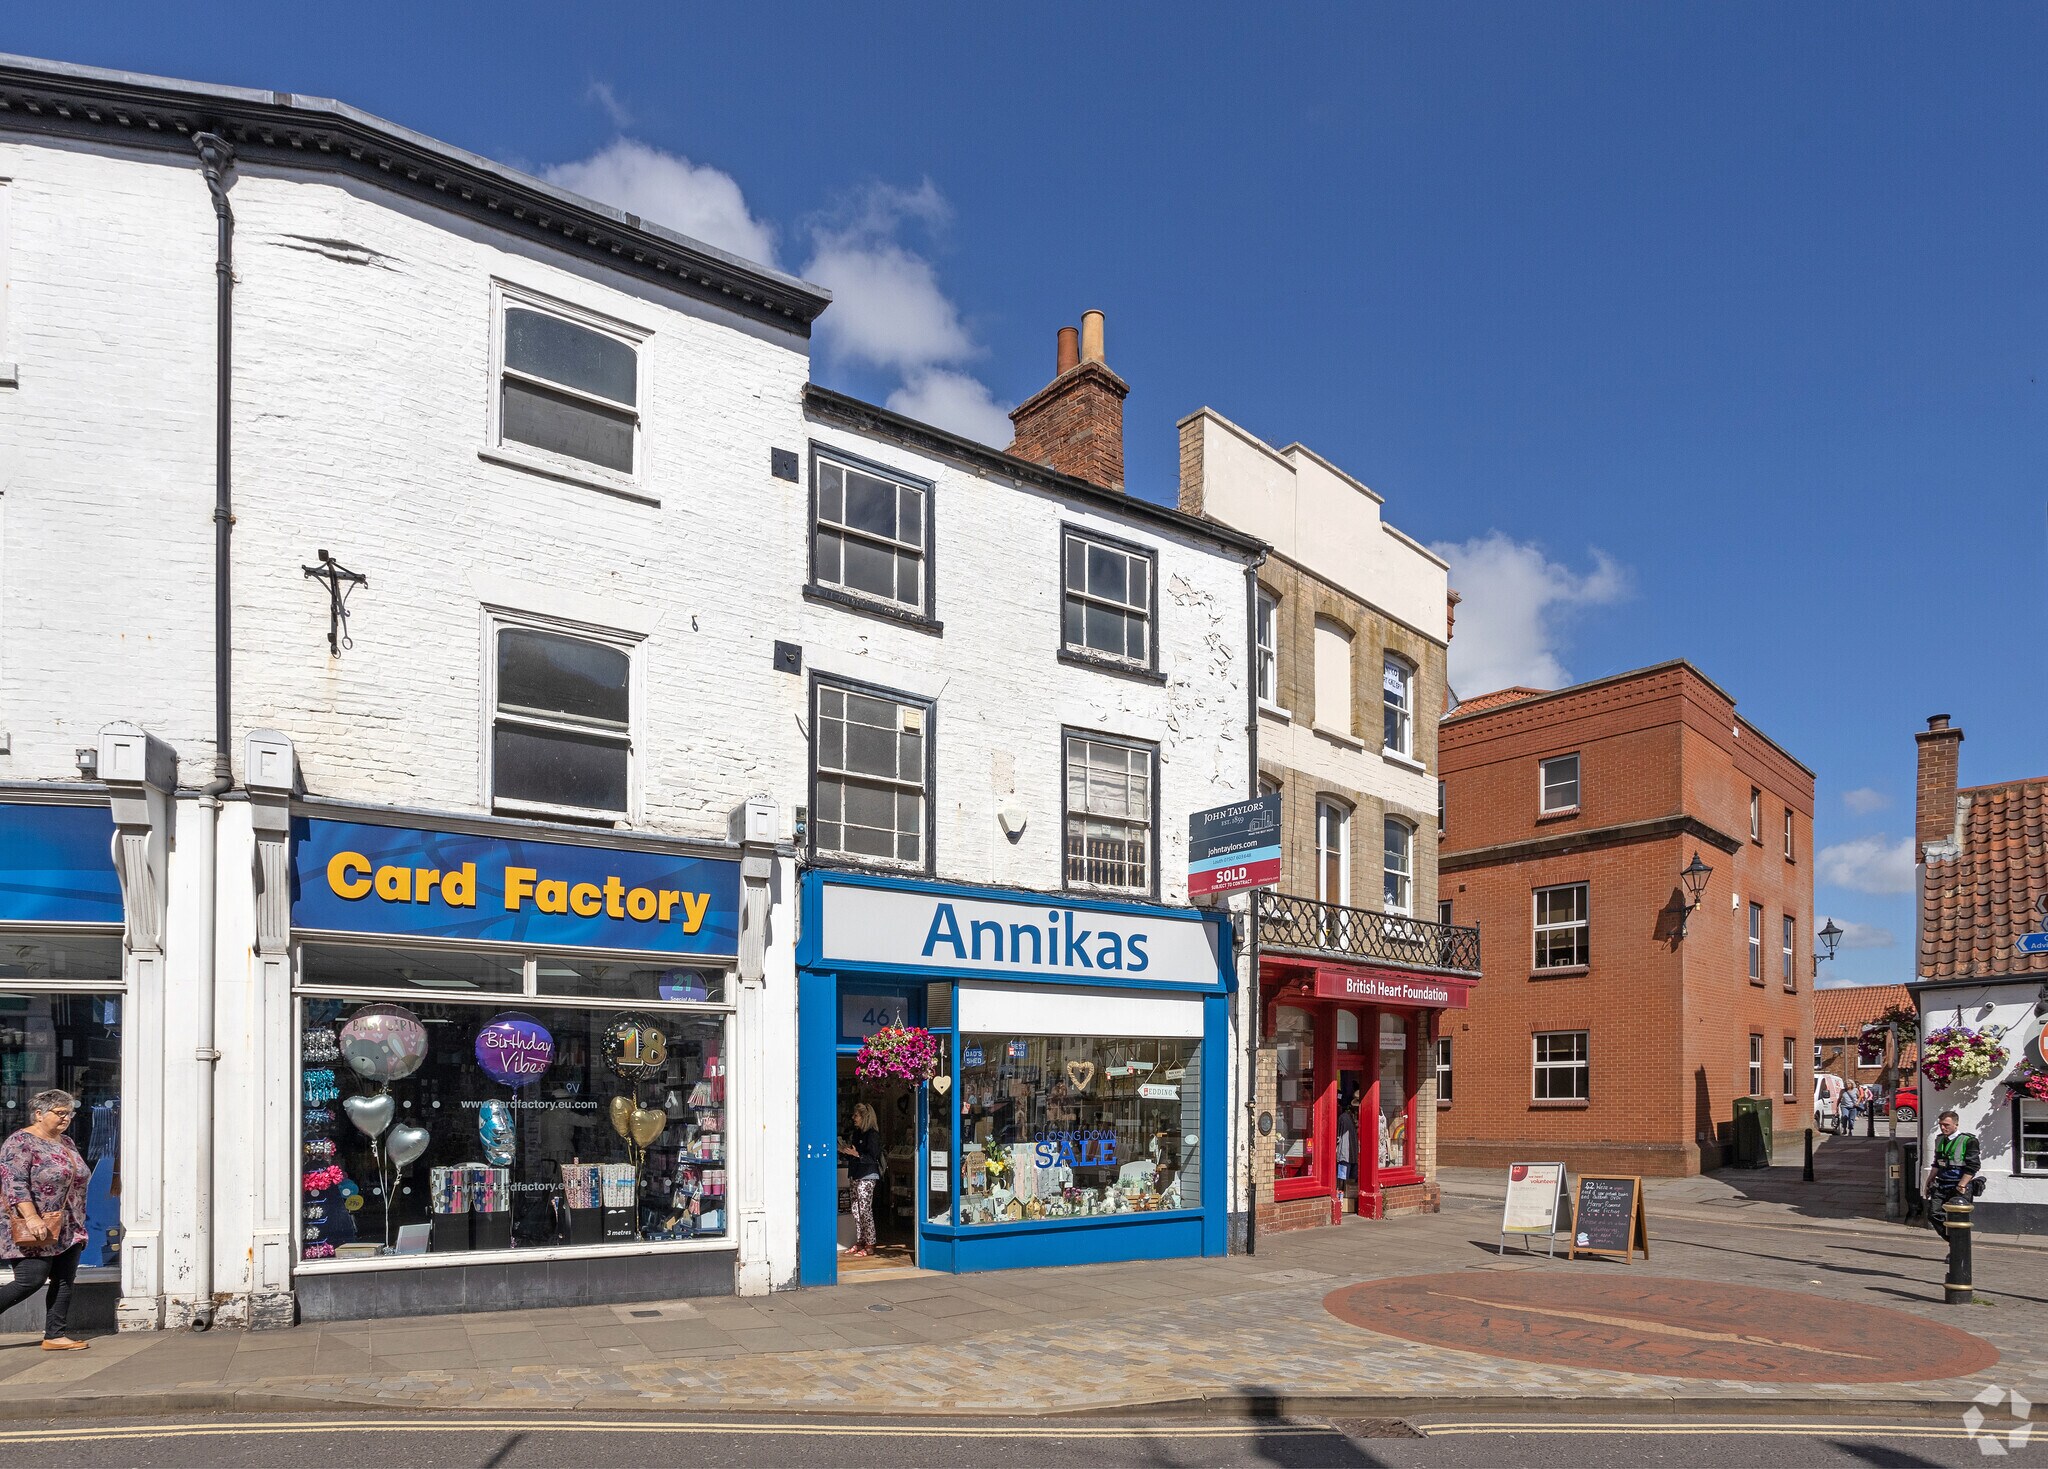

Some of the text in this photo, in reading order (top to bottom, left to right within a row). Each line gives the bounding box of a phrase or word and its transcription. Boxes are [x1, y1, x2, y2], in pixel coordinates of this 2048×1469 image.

[1204, 802, 1264, 826] JOHN TAYLORS
[1207, 840, 1258, 857] johntaylors.com
[1211, 883, 1227, 891] SUBJECT
[1233, 879, 1253, 887] CONTRACT
[1216, 867, 1247, 883] SOLD
[327, 851, 711, 934] Card Factory
[921, 903, 1149, 972] Annikas
[672, 974, 693, 991] 21
[1346, 978, 1448, 1001] British Heart Foundation
[862, 1007, 890, 1026] 46
[481, 1029, 552, 1057] Birthday
[616, 1027, 668, 1066] 18
[500, 1051, 546, 1074] Vibes
[1147, 1087, 1173, 1097] EDDING
[1034, 1128, 1117, 1143] CLOSING DOWN
[1035, 1139, 1117, 1169] SALE
